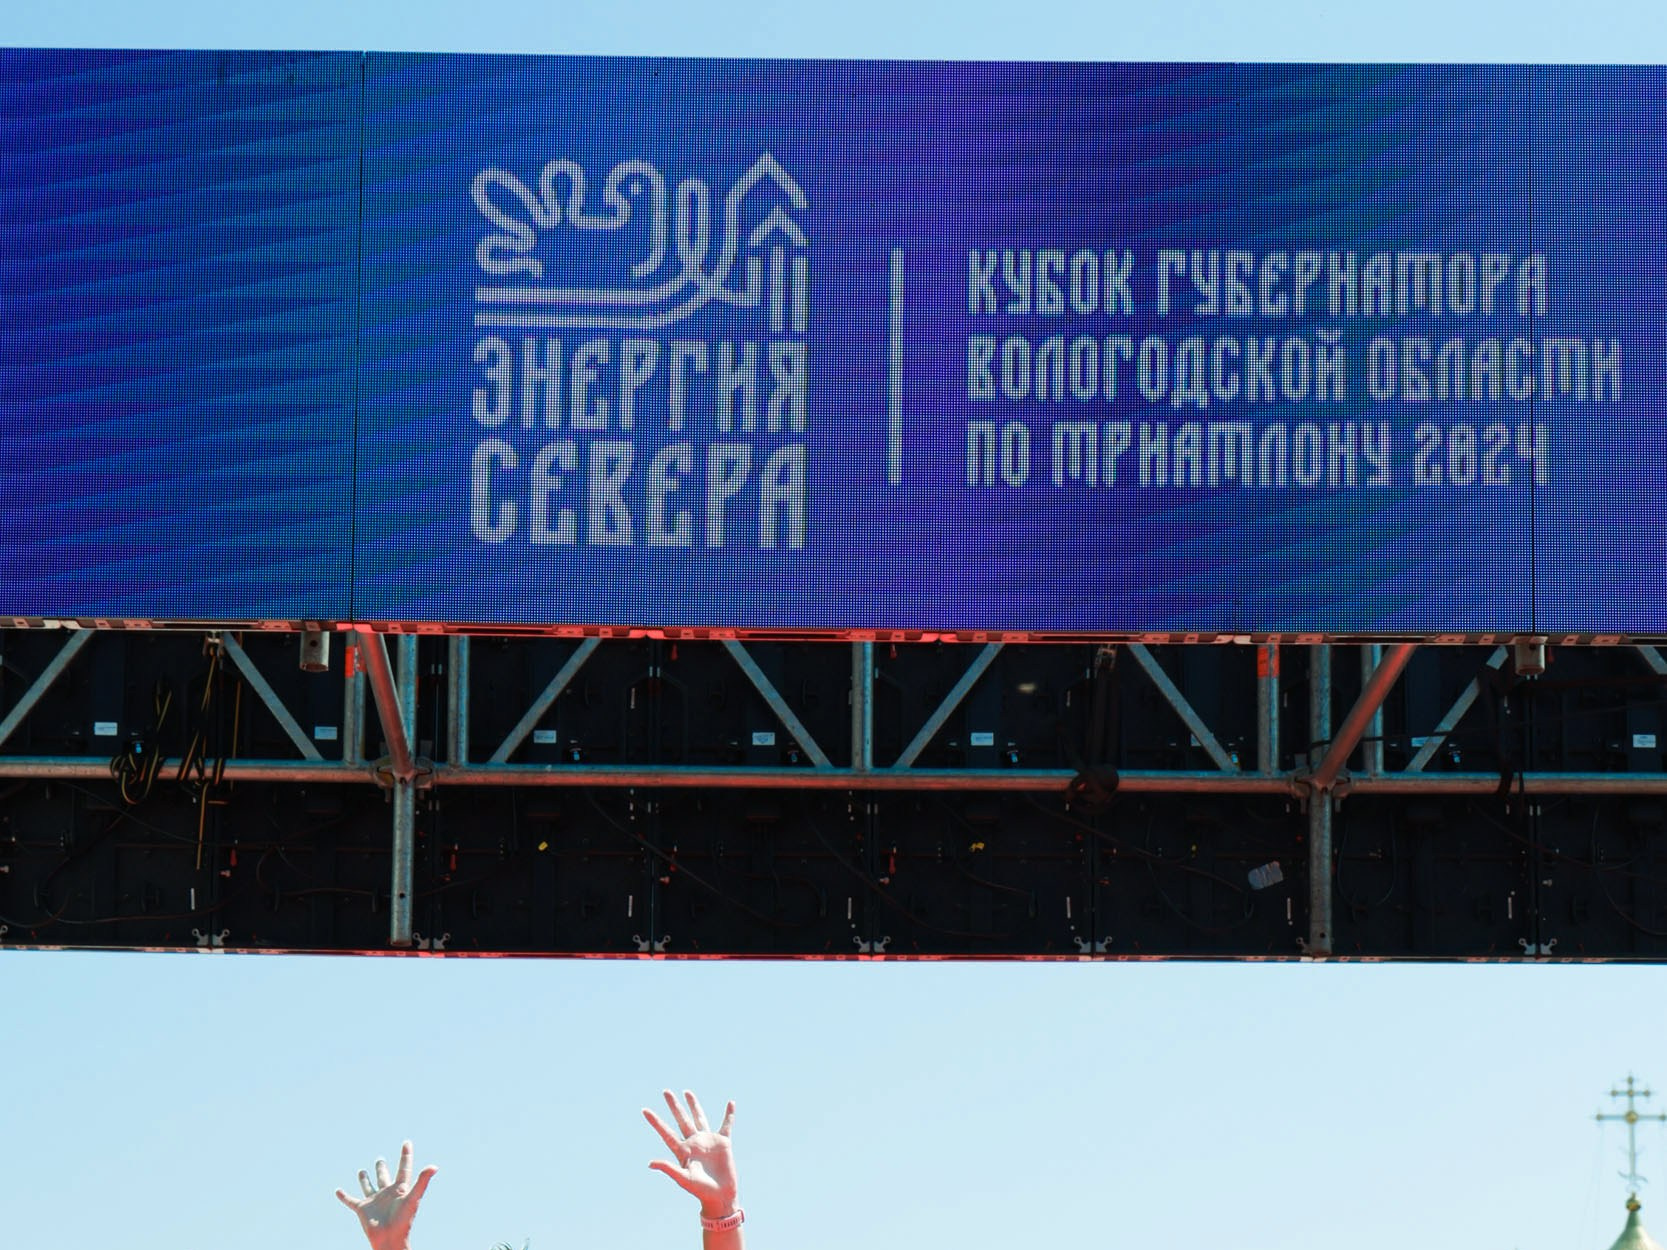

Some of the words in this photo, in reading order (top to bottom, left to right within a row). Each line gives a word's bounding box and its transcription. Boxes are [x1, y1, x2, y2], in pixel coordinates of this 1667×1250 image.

[967, 248, 1135, 316] КУБОК
[1156, 250, 1548, 317] ГУБЕРНАТОРА
[472, 336, 808, 432] ЭНЕРГИЯ
[966, 329, 1346, 408] ВОЛОГОДСКОЙ
[1369, 337, 1622, 402] ОБЛАСТИ
[471, 437, 808, 549] СЕВЕРА
[966, 421, 1030, 487] ПО
[1052, 421, 1393, 487] ТРИАТЛОНУ
[1412, 422, 1550, 487] 2024
